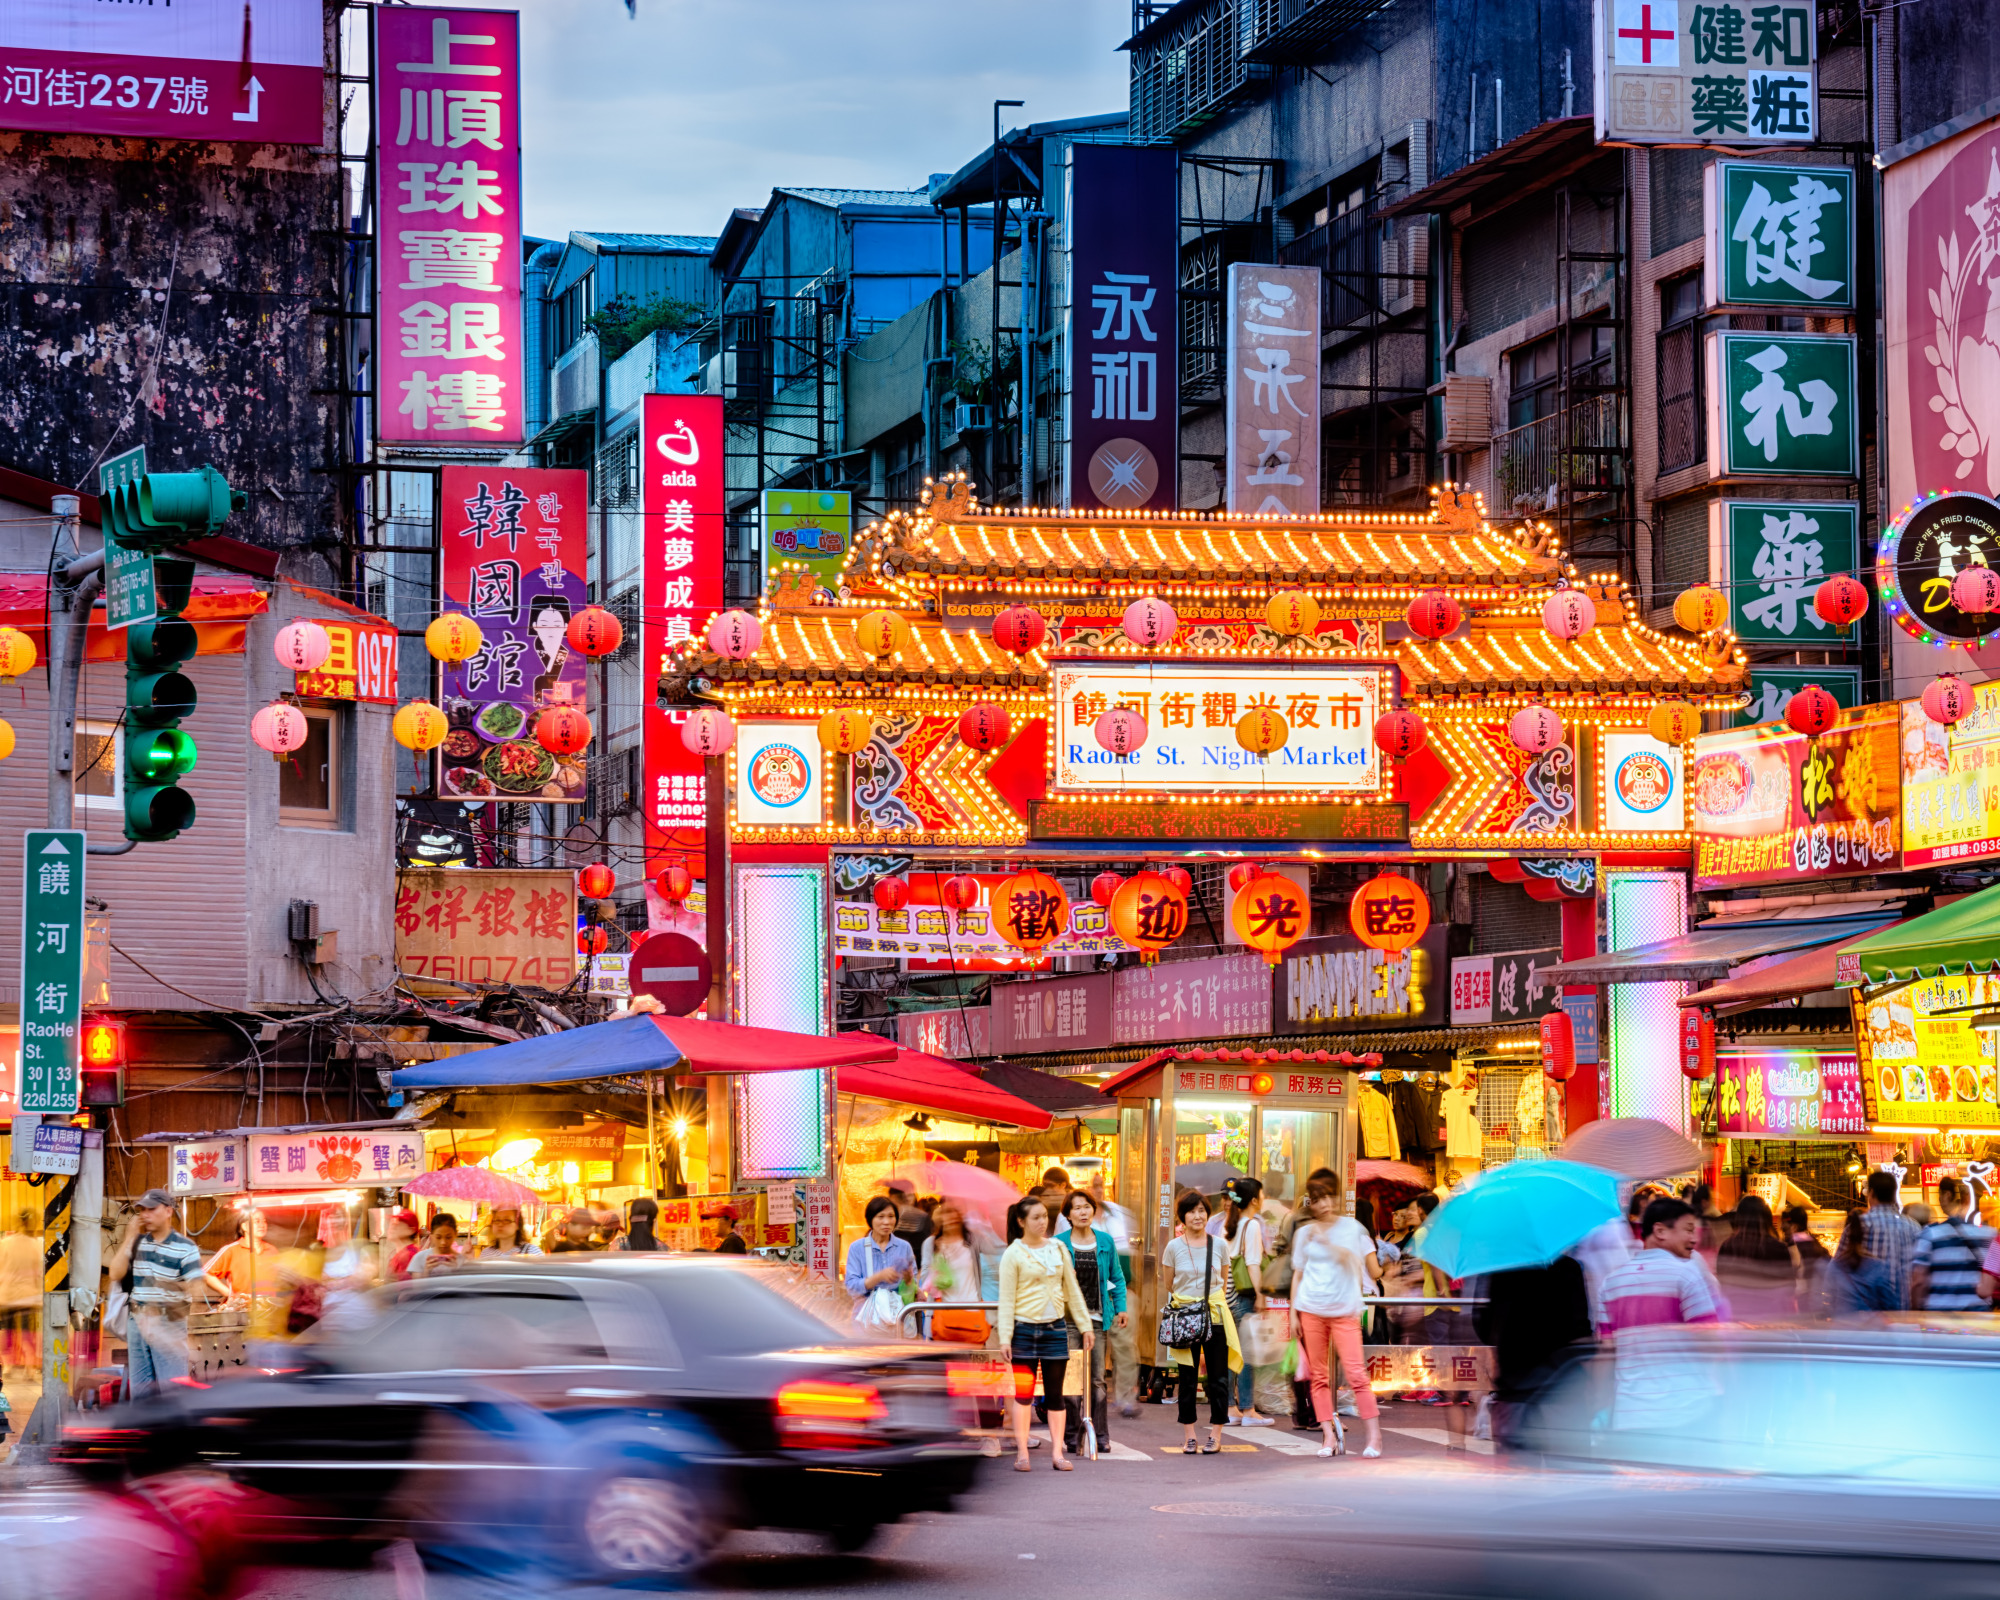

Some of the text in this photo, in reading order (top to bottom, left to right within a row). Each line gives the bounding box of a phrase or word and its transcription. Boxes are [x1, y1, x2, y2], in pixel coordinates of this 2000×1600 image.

[1689, 4, 1810, 66] 健和
[2, 66, 209, 116] 河街237號
[1619, 80, 1679, 128] 健保
[1691, 74, 1810, 136] 藥粧
[396, 18, 506, 432] 上順珠寶銀樓
[1732, 175, 1846, 299] 健
[1091, 271, 1158, 421] 永和
[1740, 344, 1838, 463] 和
[662, 471, 697, 488] aida
[535, 493, 568, 589] 한국관
[1922, 527, 1934, 541] PIE
[1933, 522, 1940, 530] &
[1940, 514, 1963, 526] FRIED
[1964, 515, 1997, 537] CHICKEN
[460, 481, 530, 693] 韓國館
[1742, 511, 1832, 636] 藥
[1146, 603, 1157, 639] 天上聖母
[1288, 595, 1301, 630] 天上聖母
[293, 628, 304, 665] 天上聖母
[585, 614, 597, 652] 天上聖母
[731, 616, 741, 654] 天上聖母
[880, 616, 892, 650] 天上聖母
[978, 709, 989, 745] 天上聖母
[1260, 711, 1272, 744] 天上聖母
[1814, 692, 1825, 727] 天上聖母
[700, 715, 710, 751] 天上聖母
[839, 714, 850, 748] 天上聖母
[1400, 717, 1411, 752] 天上聖母
[1538, 712, 1548, 748] 天上聖母
[1156, 745, 1186, 765] St.
[1282, 745, 1368, 765] Market
[836, 906, 1108, 937] 節暨饒河市
[1007, 889, 1062, 941] 歡
[1136, 893, 1183, 942] 迎
[1249, 893, 1301, 938] 光
[1365, 894, 1416, 936] 臨
[36, 862, 71, 1015] 饒河街
[1157, 974, 1221, 1024] 三禾百貨
[1454, 970, 1491, 1010] 各國名藥
[26, 1021, 74, 1037] RaoHe
[1014, 992, 1042, 1041] 永和
[25, 1043, 45, 1059] St.
[28, 1066, 43, 1081] 30
[56, 1066, 72, 1081] 33
[1288, 1075, 1344, 1095] 服務台
[23, 1092, 47, 1107] 226
[52, 1093, 76, 1107] 255
[56, 1143, 80, 1154] Crossing
[1160, 1184, 1171, 1228] 請靠右走
[812, 1238, 829, 1281] 禁止進入
